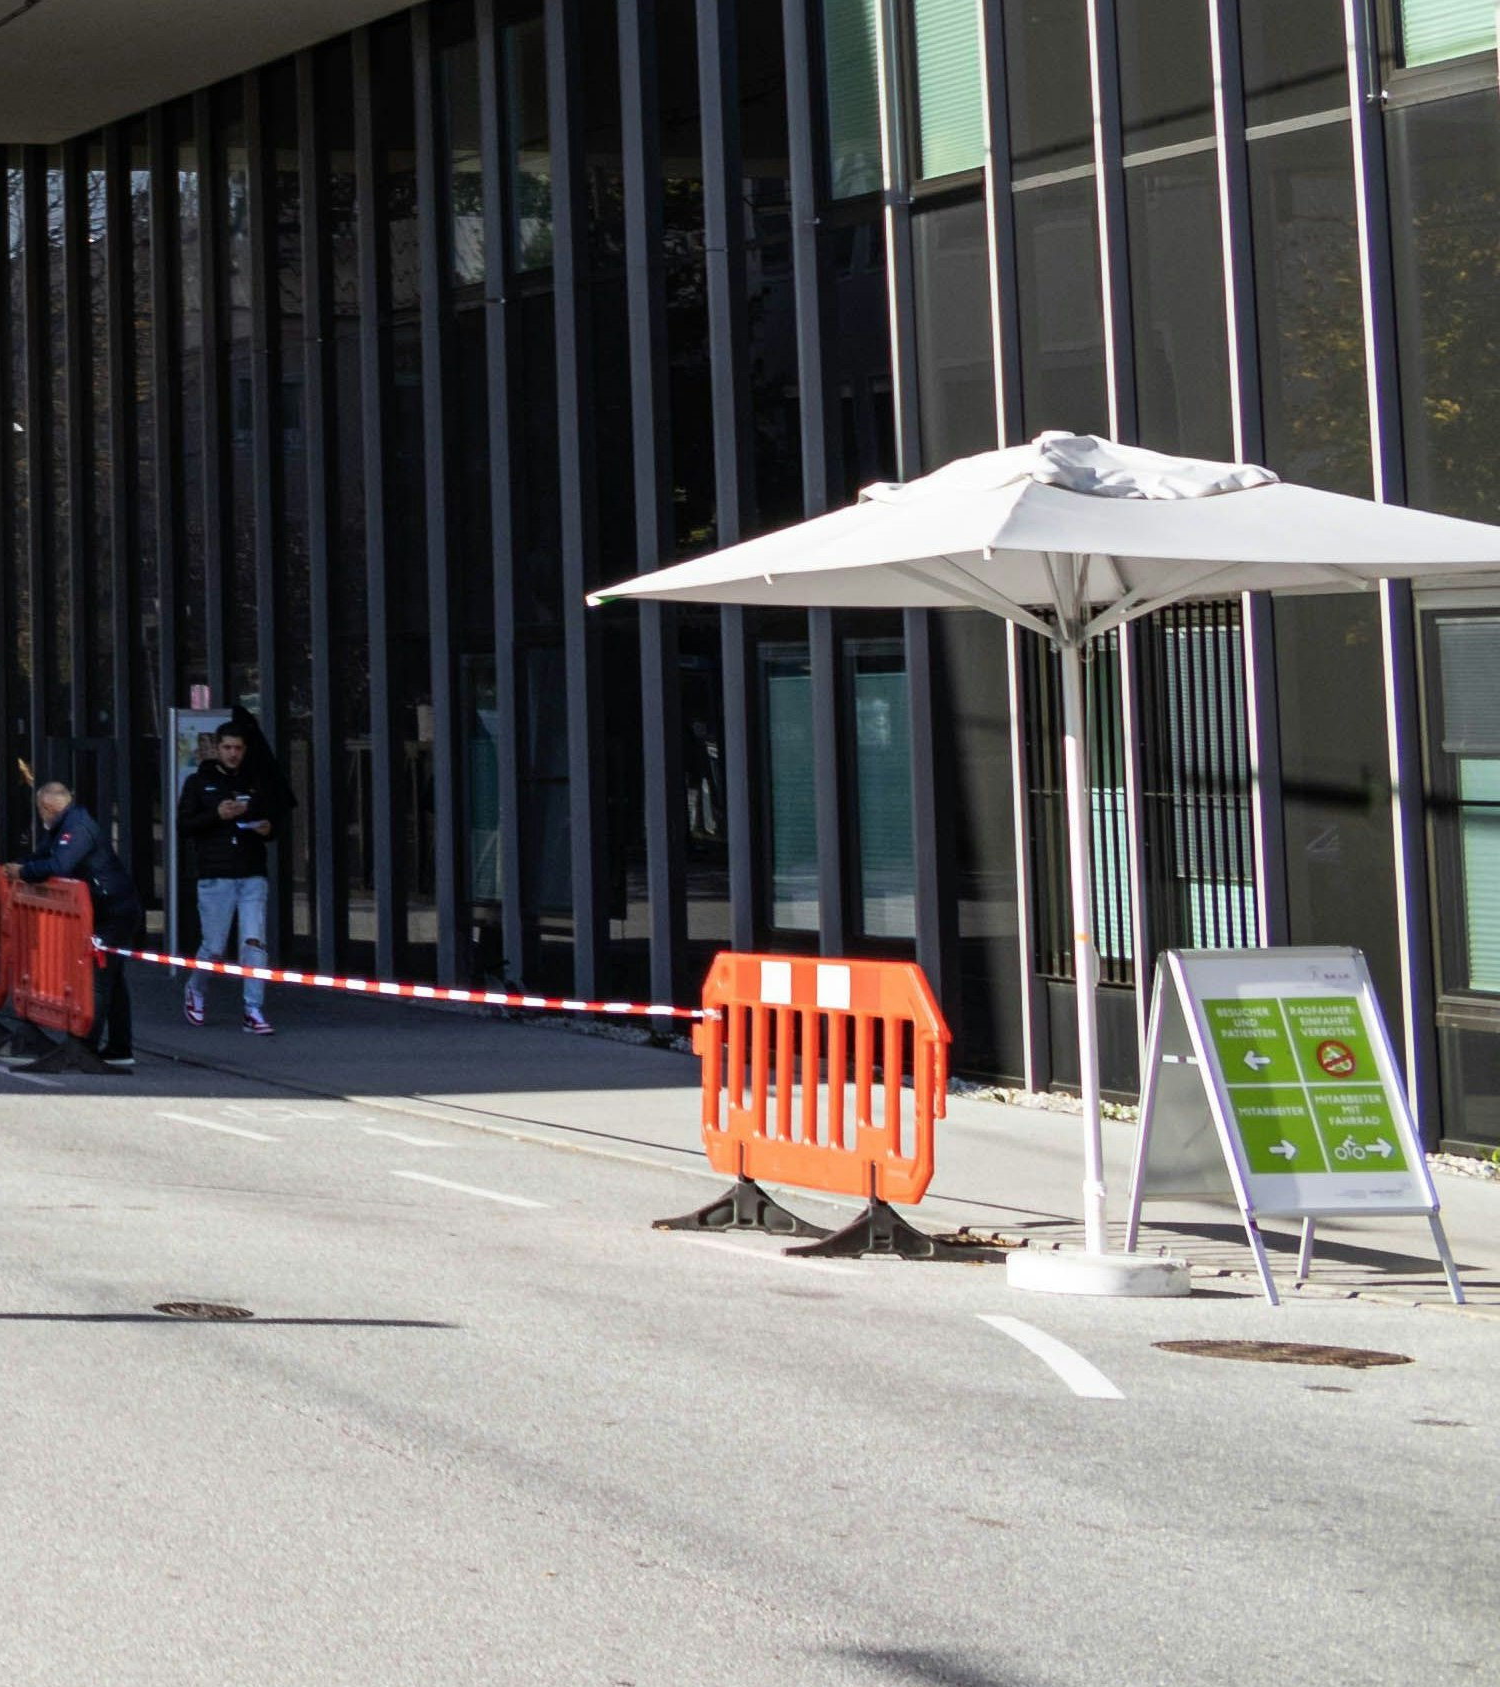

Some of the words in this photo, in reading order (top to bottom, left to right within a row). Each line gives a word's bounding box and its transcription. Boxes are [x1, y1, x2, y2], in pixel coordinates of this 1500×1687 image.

[1215, 1006, 1271, 1018] BESUCHER
[1233, 1018, 1259, 1028] UND
[1299, 1016, 1351, 1027] EINFAHRT
[1220, 1028, 1277, 1039] PATIENTEN
[1301, 1027, 1357, 1038] VERBOTEN
[1314, 1094, 1382, 1105] MITARBEITER
[1238, 1106, 1305, 1117] MITARBEITER
[1341, 1104, 1361, 1114] MIT
[1328, 1116, 1381, 1126] FAHRRAD
